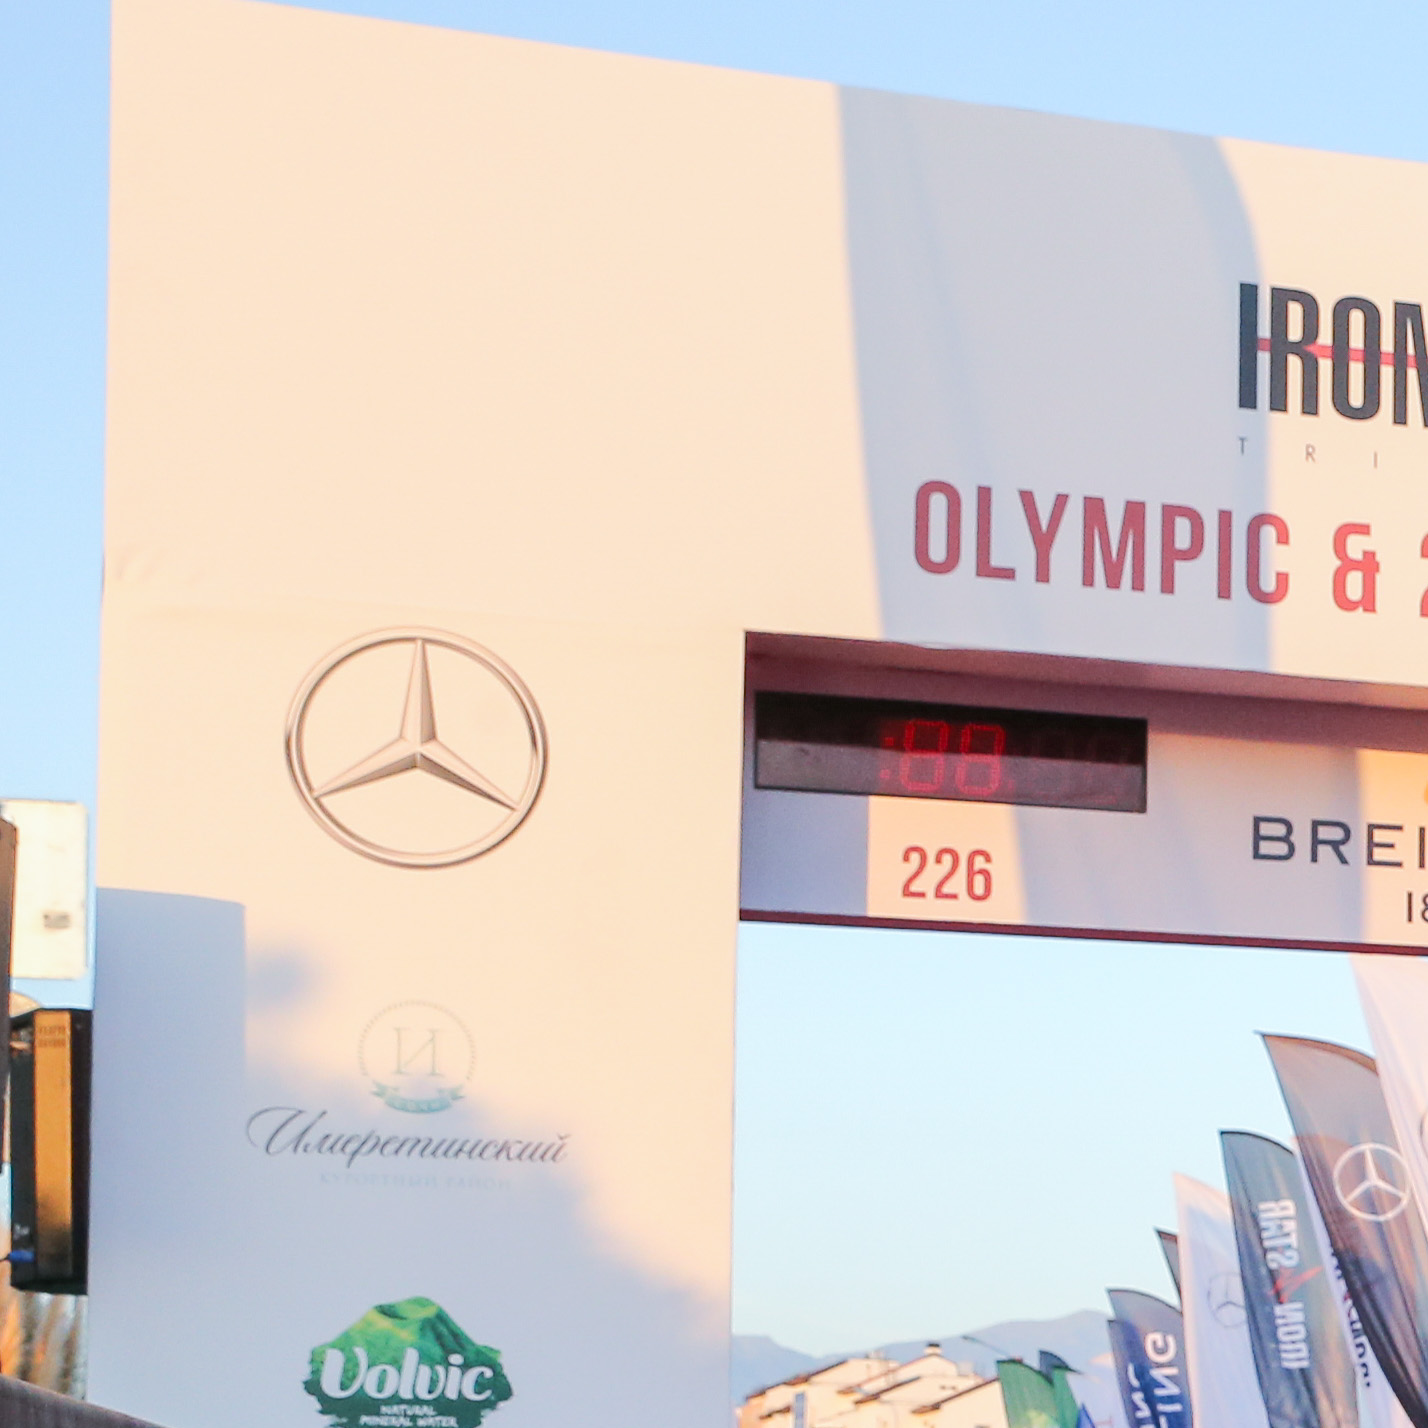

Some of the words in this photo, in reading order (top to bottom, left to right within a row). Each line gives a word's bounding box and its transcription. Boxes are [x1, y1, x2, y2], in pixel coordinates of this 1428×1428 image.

[914, 480, 1290, 605] OLYMPIC
[1332, 523, 1380, 613] &
[902, 846, 992, 901] 226
[246, 1106, 572, 1168] Имеретинский
[320, 1347, 494, 1401] Volvic
